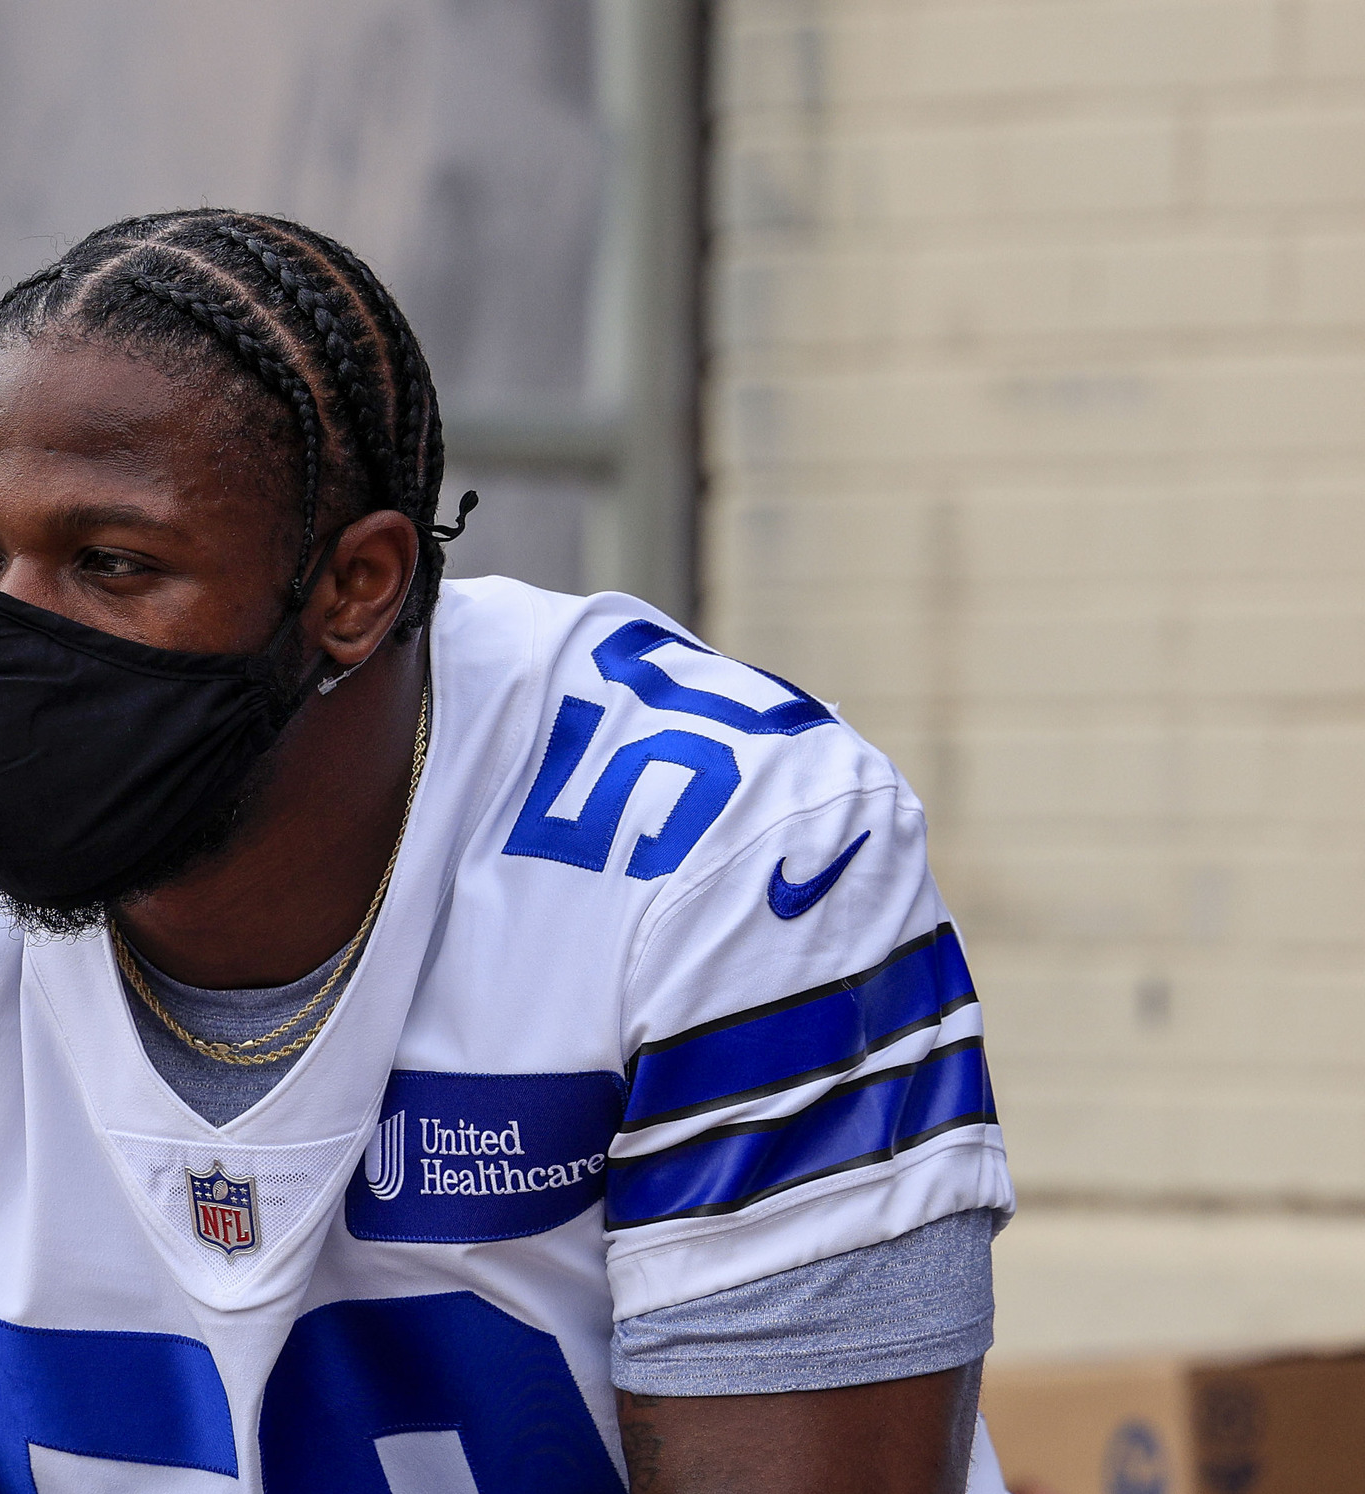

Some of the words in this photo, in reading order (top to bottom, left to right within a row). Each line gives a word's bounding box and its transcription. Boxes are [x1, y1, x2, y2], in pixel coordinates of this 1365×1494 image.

[420, 1117, 525, 1155] United
[420, 1152, 604, 1197] Healthcare
[200, 1203, 252, 1246] NFL
